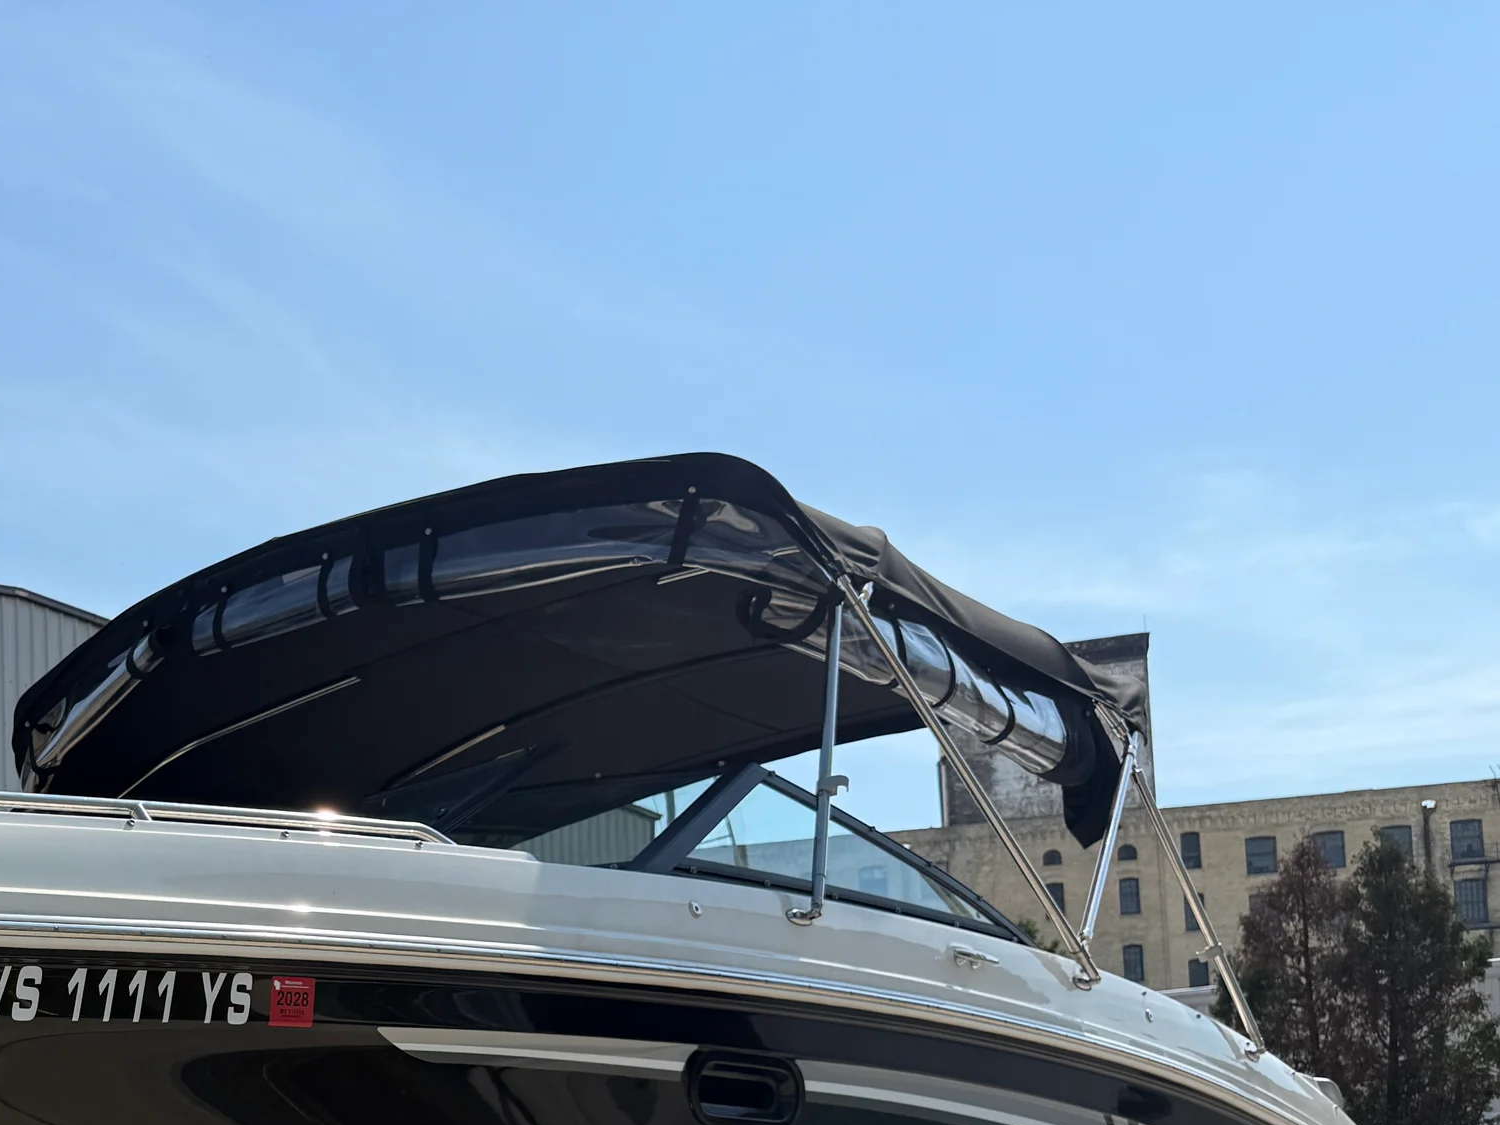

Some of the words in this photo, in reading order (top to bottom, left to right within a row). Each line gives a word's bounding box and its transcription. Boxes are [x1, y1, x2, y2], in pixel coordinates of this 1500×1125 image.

[67, 967, 177, 1024] 1111
[201, 971, 253, 1026] YS
[276, 990, 309, 1007] 2028
